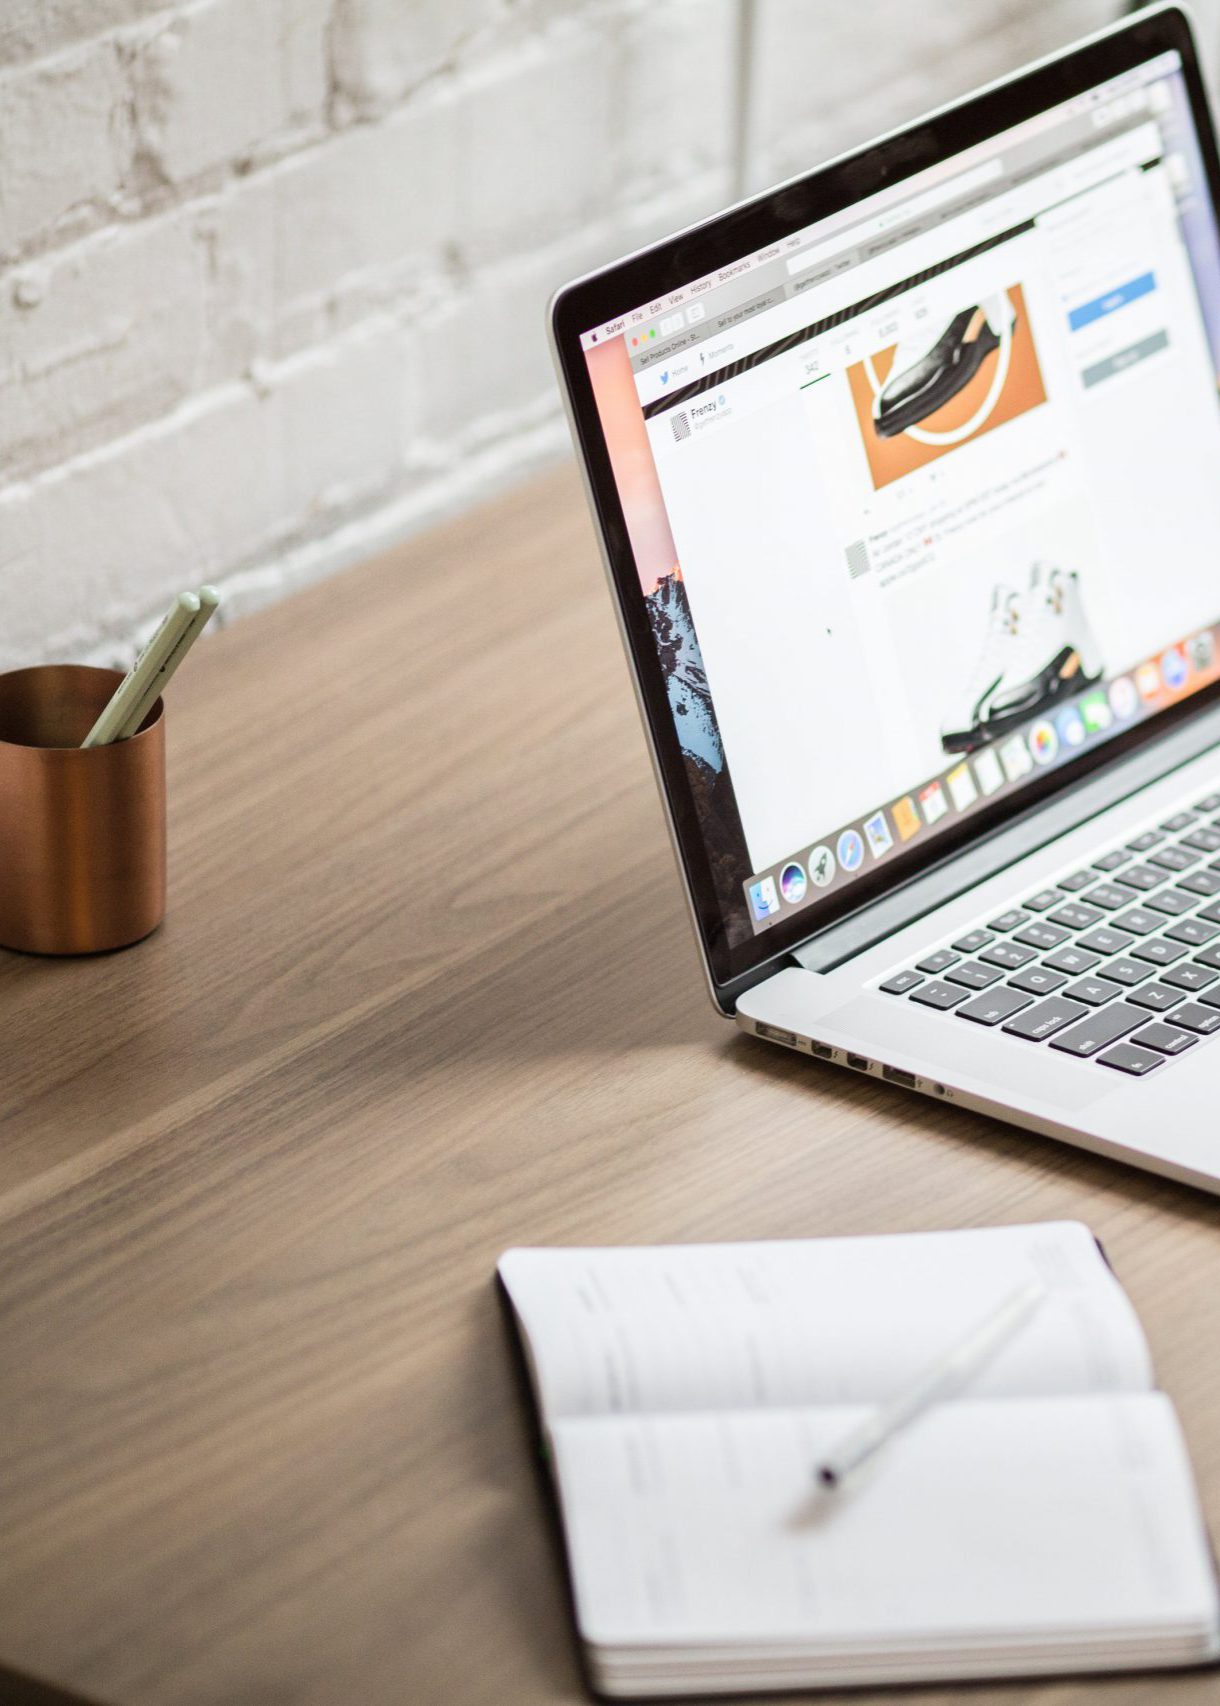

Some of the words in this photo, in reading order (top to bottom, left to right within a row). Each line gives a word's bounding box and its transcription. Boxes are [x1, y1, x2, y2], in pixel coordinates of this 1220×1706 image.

[604, 320, 626, 335] Safari
[631, 312, 644, 322] File
[649, 303, 662, 314] Edit
[668, 294, 684, 304] View
[690, 280, 712, 294] History
[718, 262, 751, 282] Bookmarks
[690, 400, 717, 419] Frenzy
[1150, 946, 1167, 955] D
[1008, 952, 1024, 961] 2
[1062, 954, 1080, 964] W
[1119, 966, 1134, 974] S
[1181, 970, 1198, 980] X
[1030, 974, 1047, 984] Q
[1086, 986, 1102, 996] A
[1148, 991, 1164, 1000] Z
[1032, 1022, 1050, 1034] caps
[1046, 1015, 1062, 1026] lock
[1198, 1014, 1220, 1028] option
[1078, 1040, 1096, 1050] shift
[1164, 1034, 1189, 1050] control
